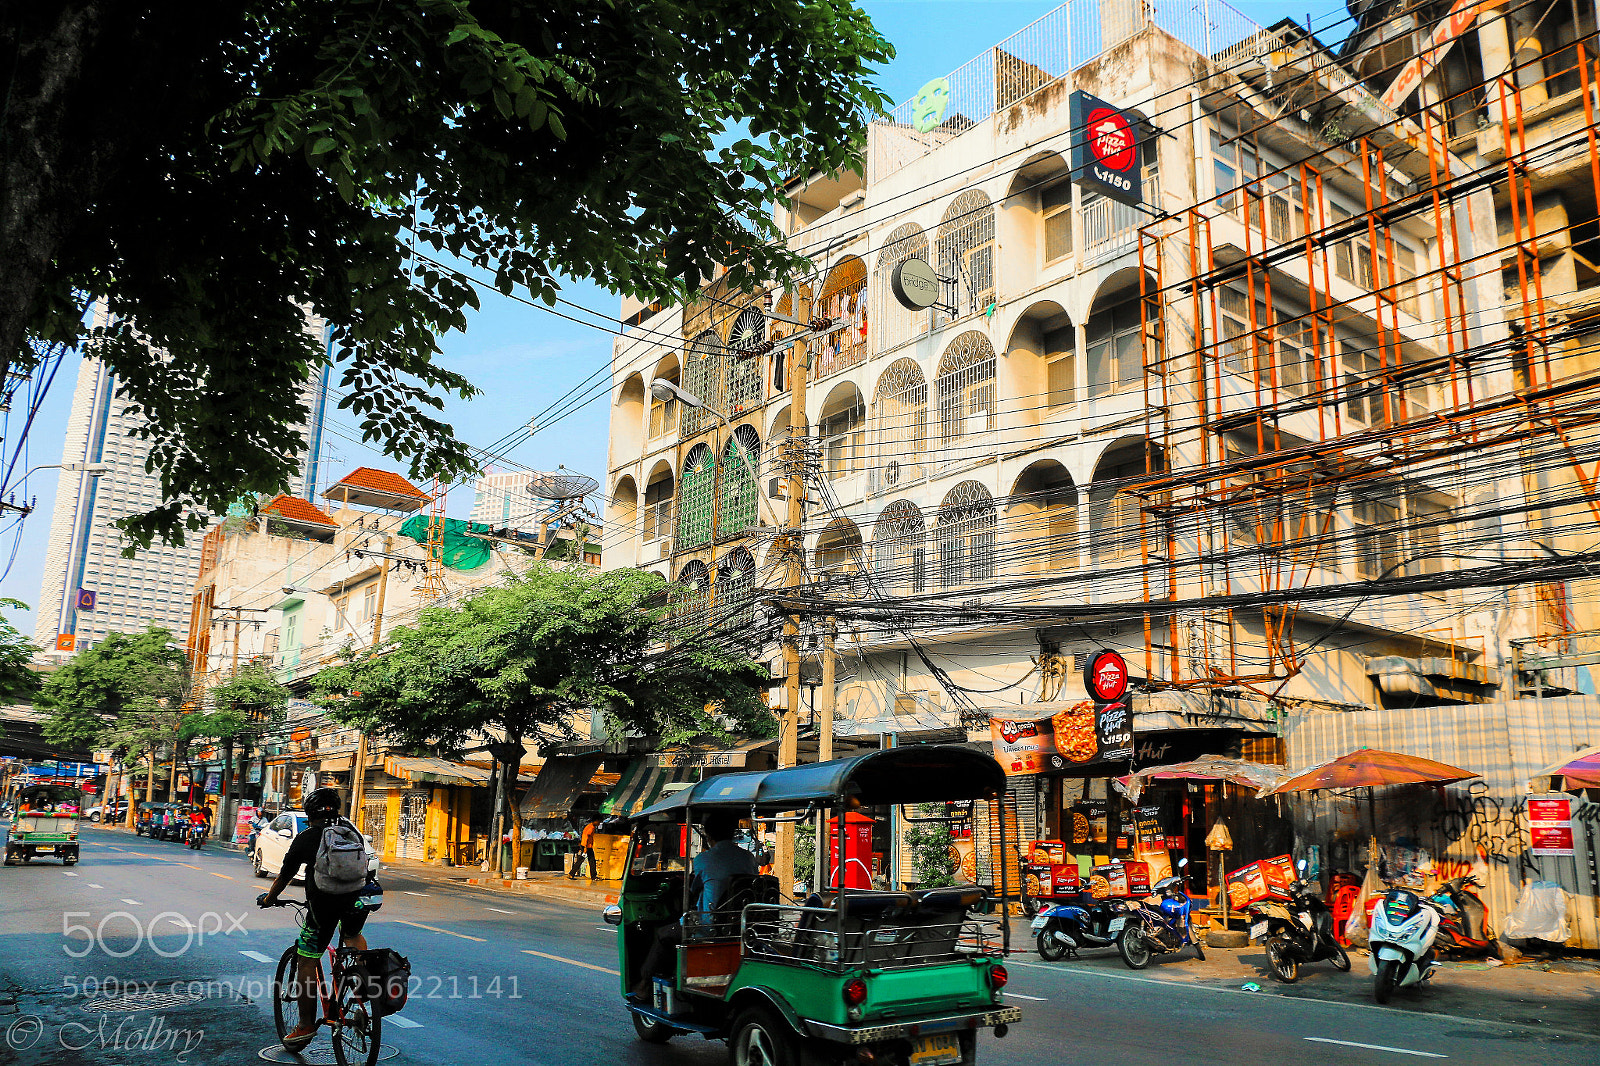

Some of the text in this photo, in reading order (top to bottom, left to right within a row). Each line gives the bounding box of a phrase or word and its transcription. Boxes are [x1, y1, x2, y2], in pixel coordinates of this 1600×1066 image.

[1096, 131, 1126, 147] Pizza
[1102, 144, 1122, 157] Hut
[1102, 170, 1131, 191] 1150
[1099, 673, 1120, 686] Pizza
[1103, 681, 1118, 691] Hut
[1100, 709, 1127, 728] Pizza
[1003, 721, 1018, 735] 99
[1104, 718, 1127, 735] Hut
[1106, 732, 1131, 745] 1150
[1138, 742, 1172, 760] Hut
